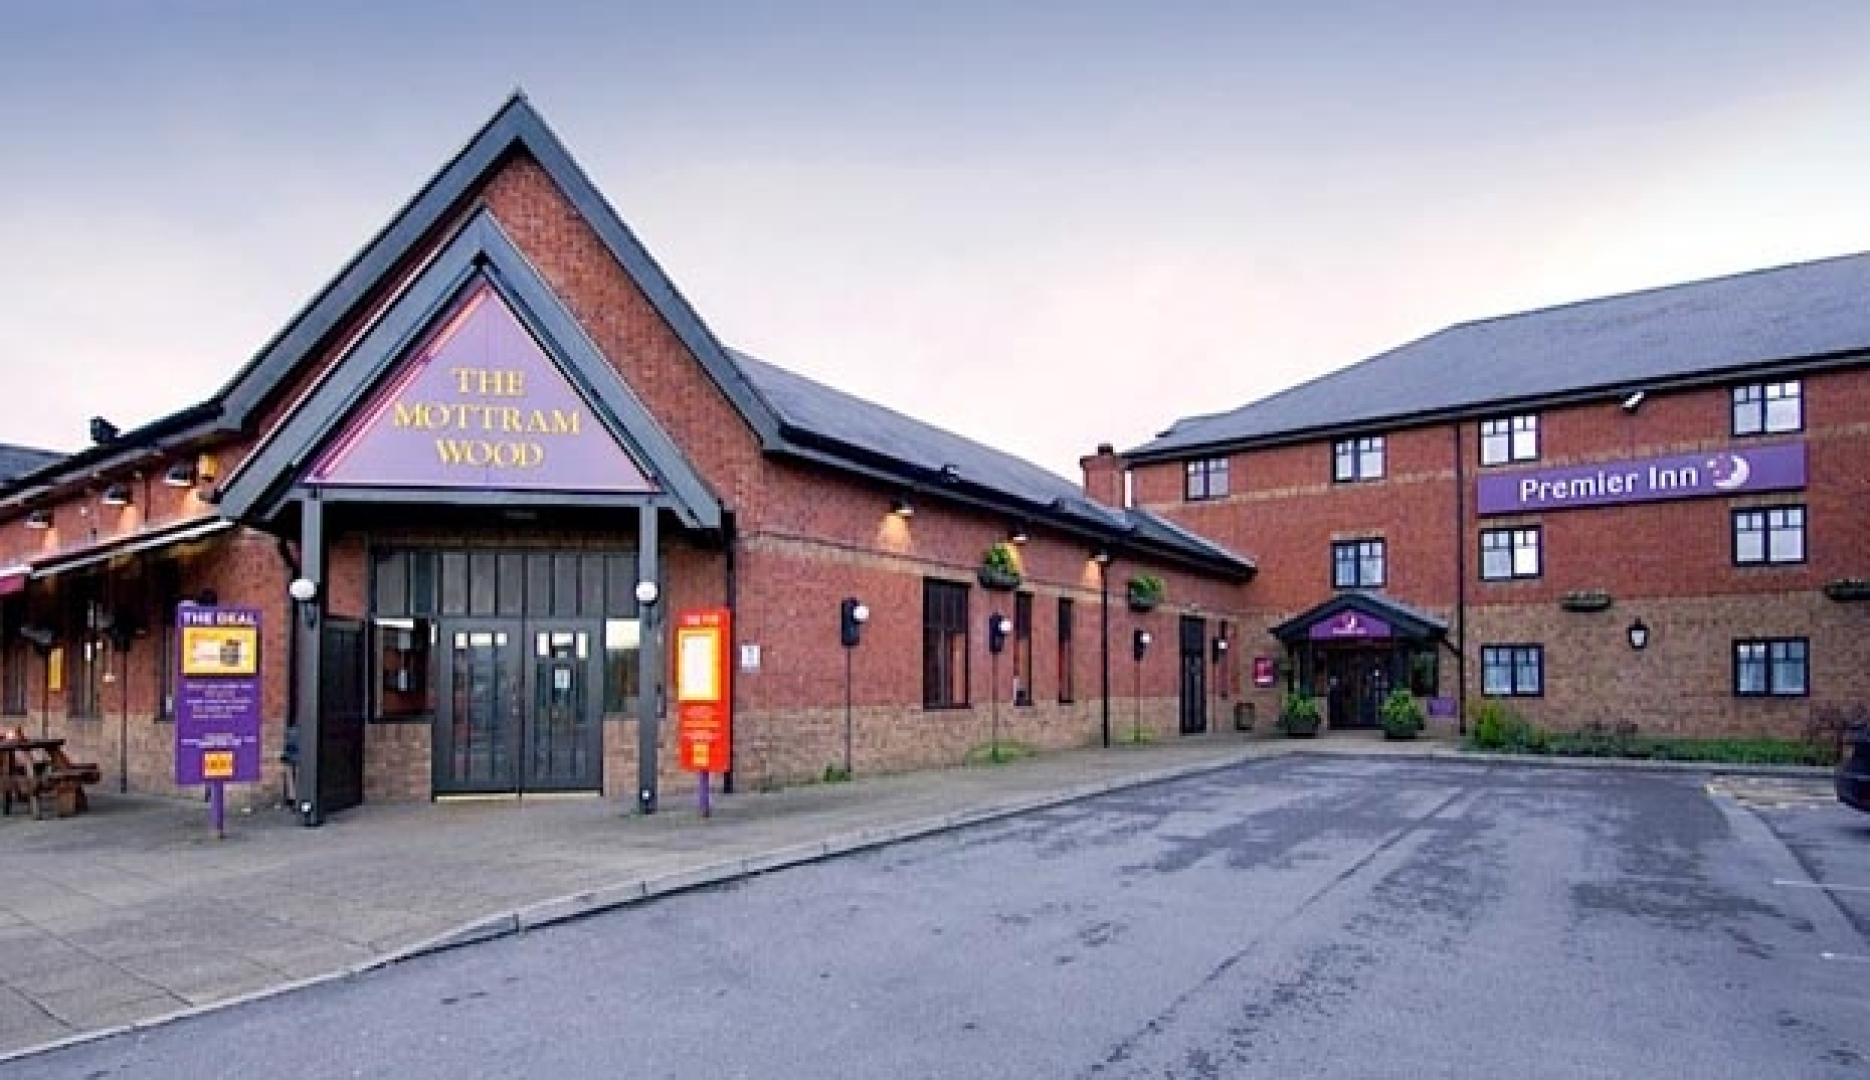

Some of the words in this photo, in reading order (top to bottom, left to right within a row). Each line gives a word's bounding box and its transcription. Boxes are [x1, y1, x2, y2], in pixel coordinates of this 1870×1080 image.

[450, 368, 523, 396] THE
[394, 402, 580, 434] MOTTRAM
[435, 438, 544, 468] WOOD
[1521, 471, 1638, 502] Premier
[1649, 466, 1698, 490] Inn
[183, 612, 212, 625] THE
